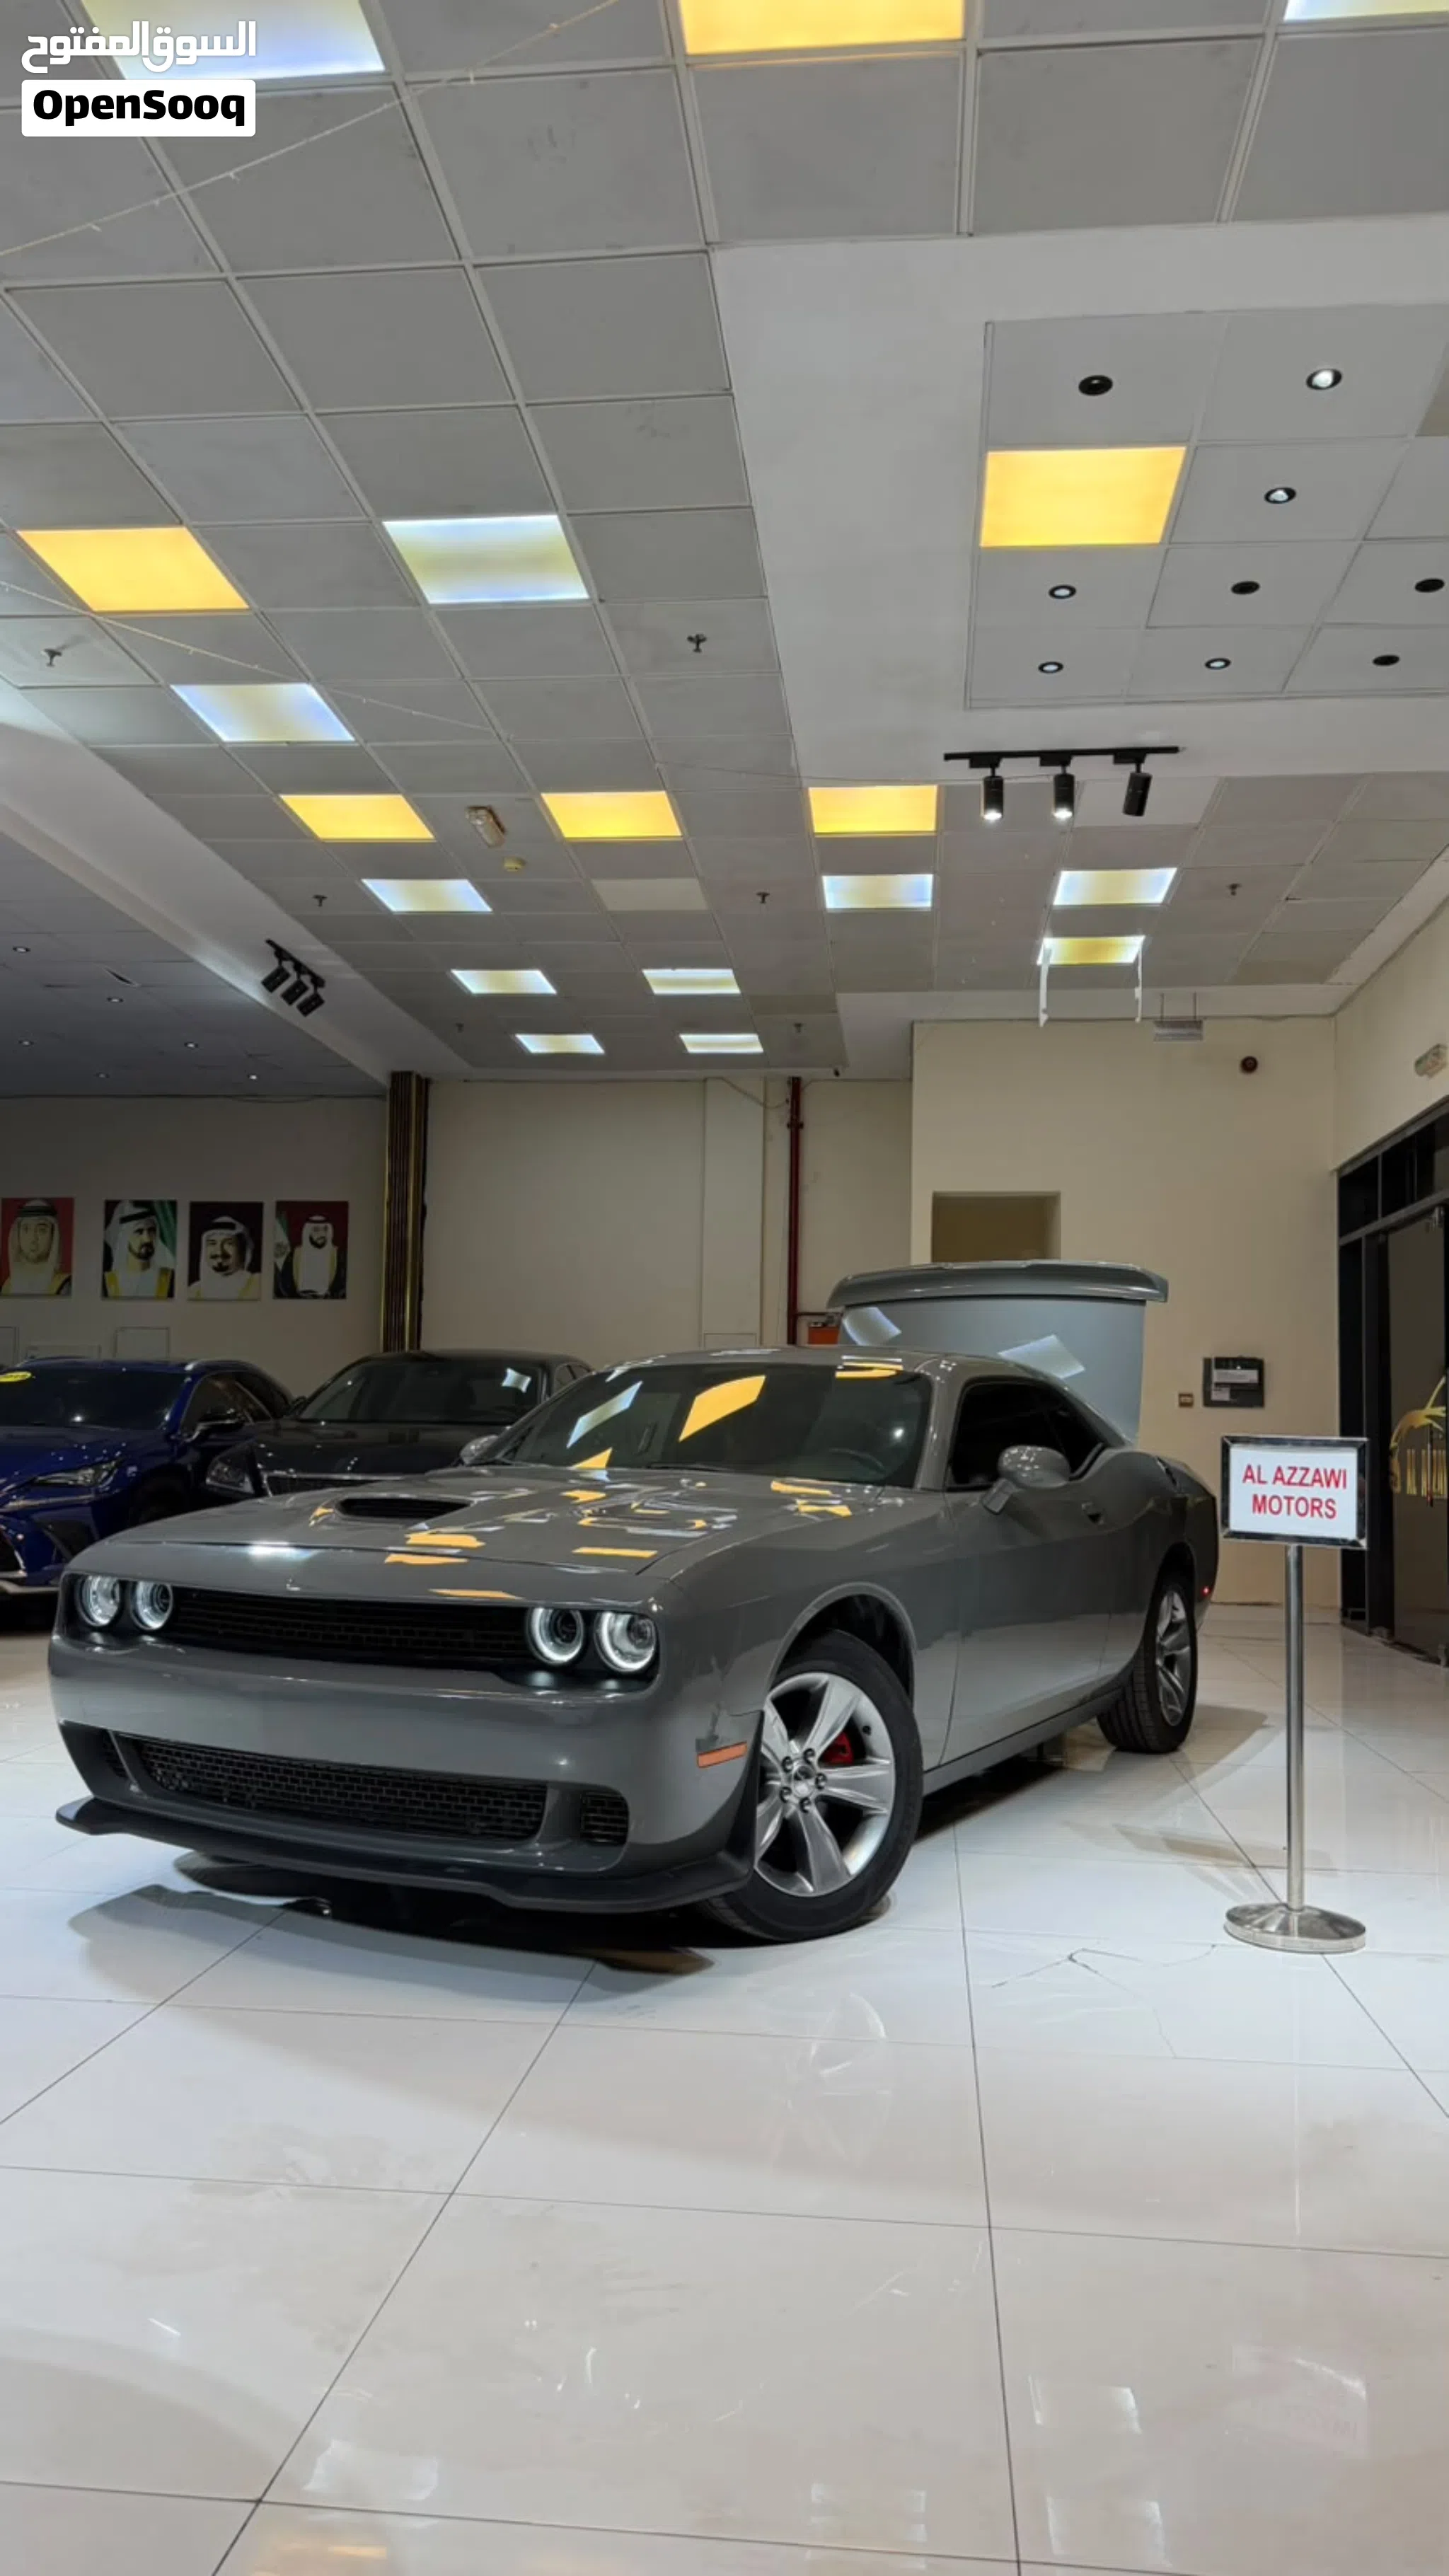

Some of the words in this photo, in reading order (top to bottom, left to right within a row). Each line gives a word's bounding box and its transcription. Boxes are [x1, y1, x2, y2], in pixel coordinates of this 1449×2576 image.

[1242, 1464, 1267, 1484] AL
[1272, 1465, 1347, 1489] AZZAWI
[1252, 1494, 1337, 1519] MOTORS
